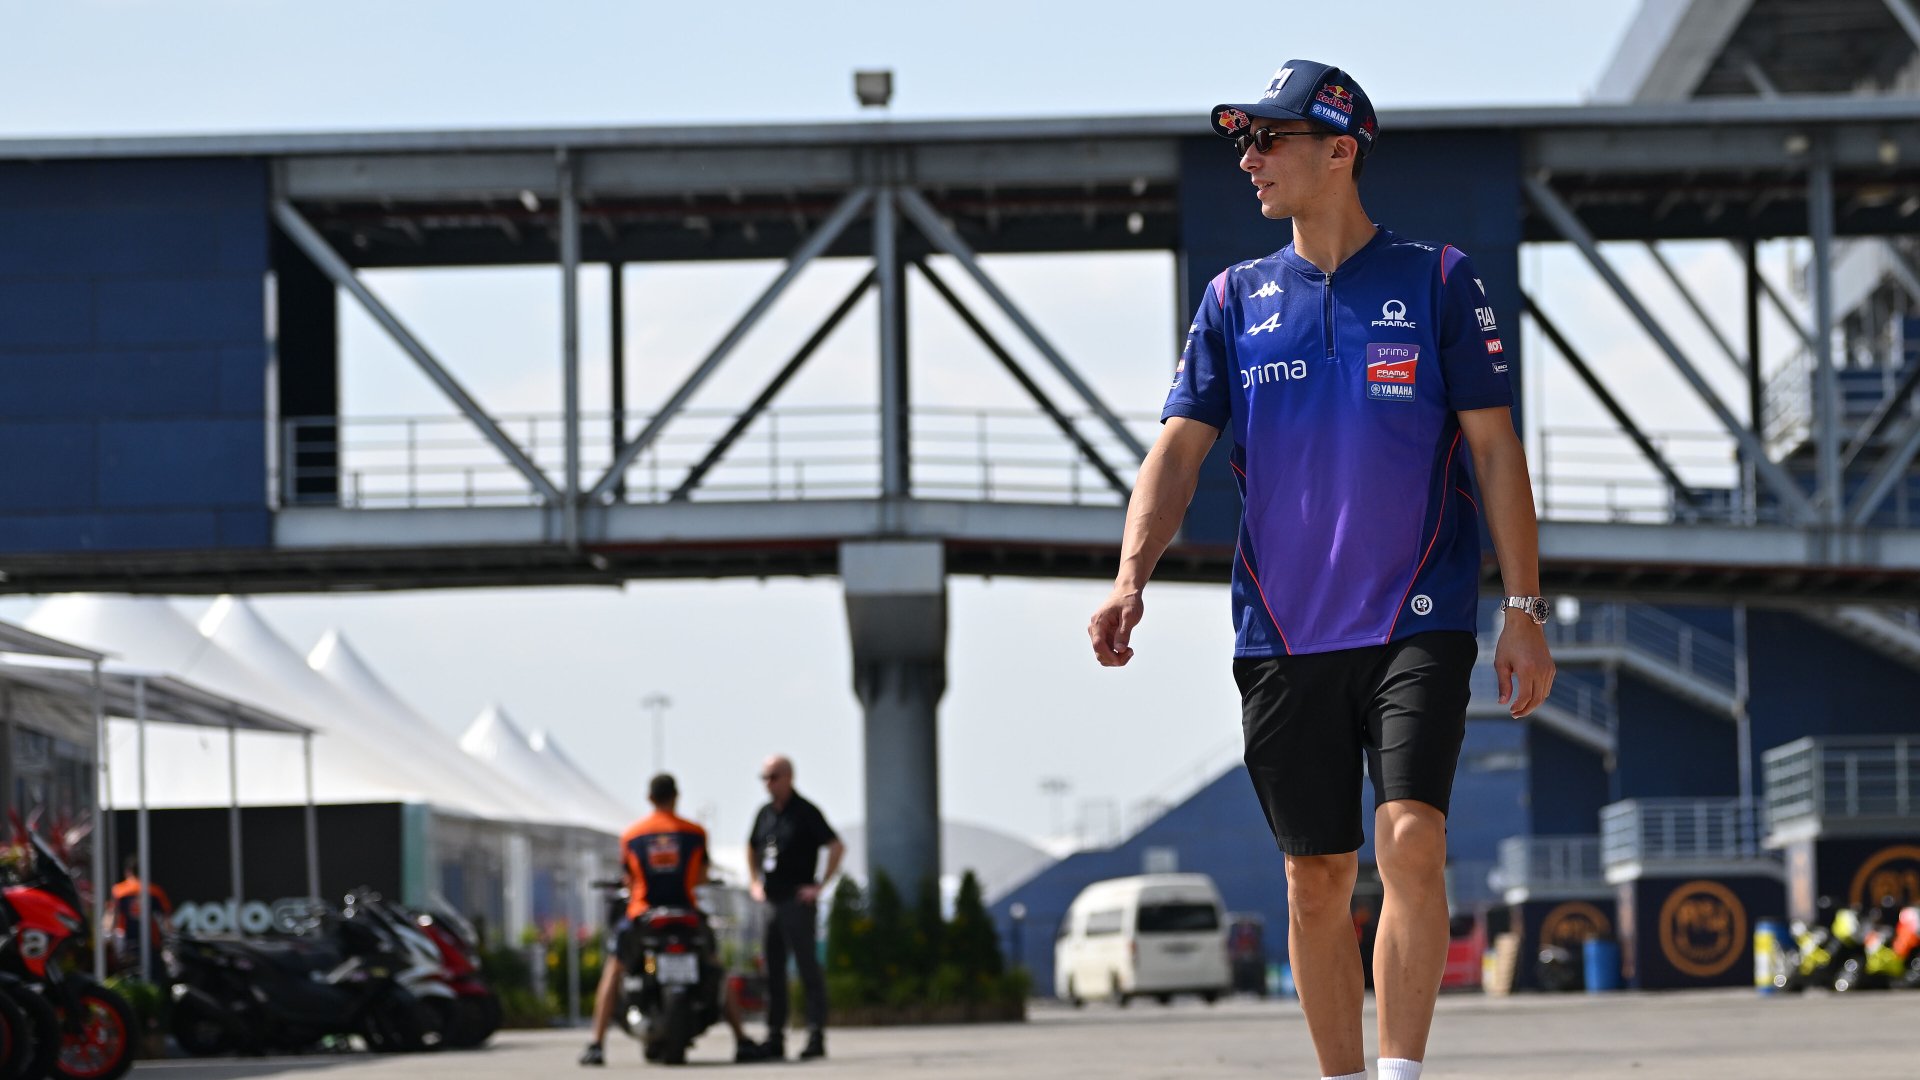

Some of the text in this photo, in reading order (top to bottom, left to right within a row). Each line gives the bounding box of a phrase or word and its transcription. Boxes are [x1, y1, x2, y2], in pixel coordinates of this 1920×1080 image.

[1316, 91, 1335, 107] Red
[1333, 98, 1354, 115] Bull
[1322, 106, 1349, 126] YAMAHA
[1371, 320, 1417, 329] PRAMAC
[1377, 347, 1409, 358] prima
[1376, 369, 1410, 377] PRAMAC
[1381, 384, 1413, 396] YAMAHA
